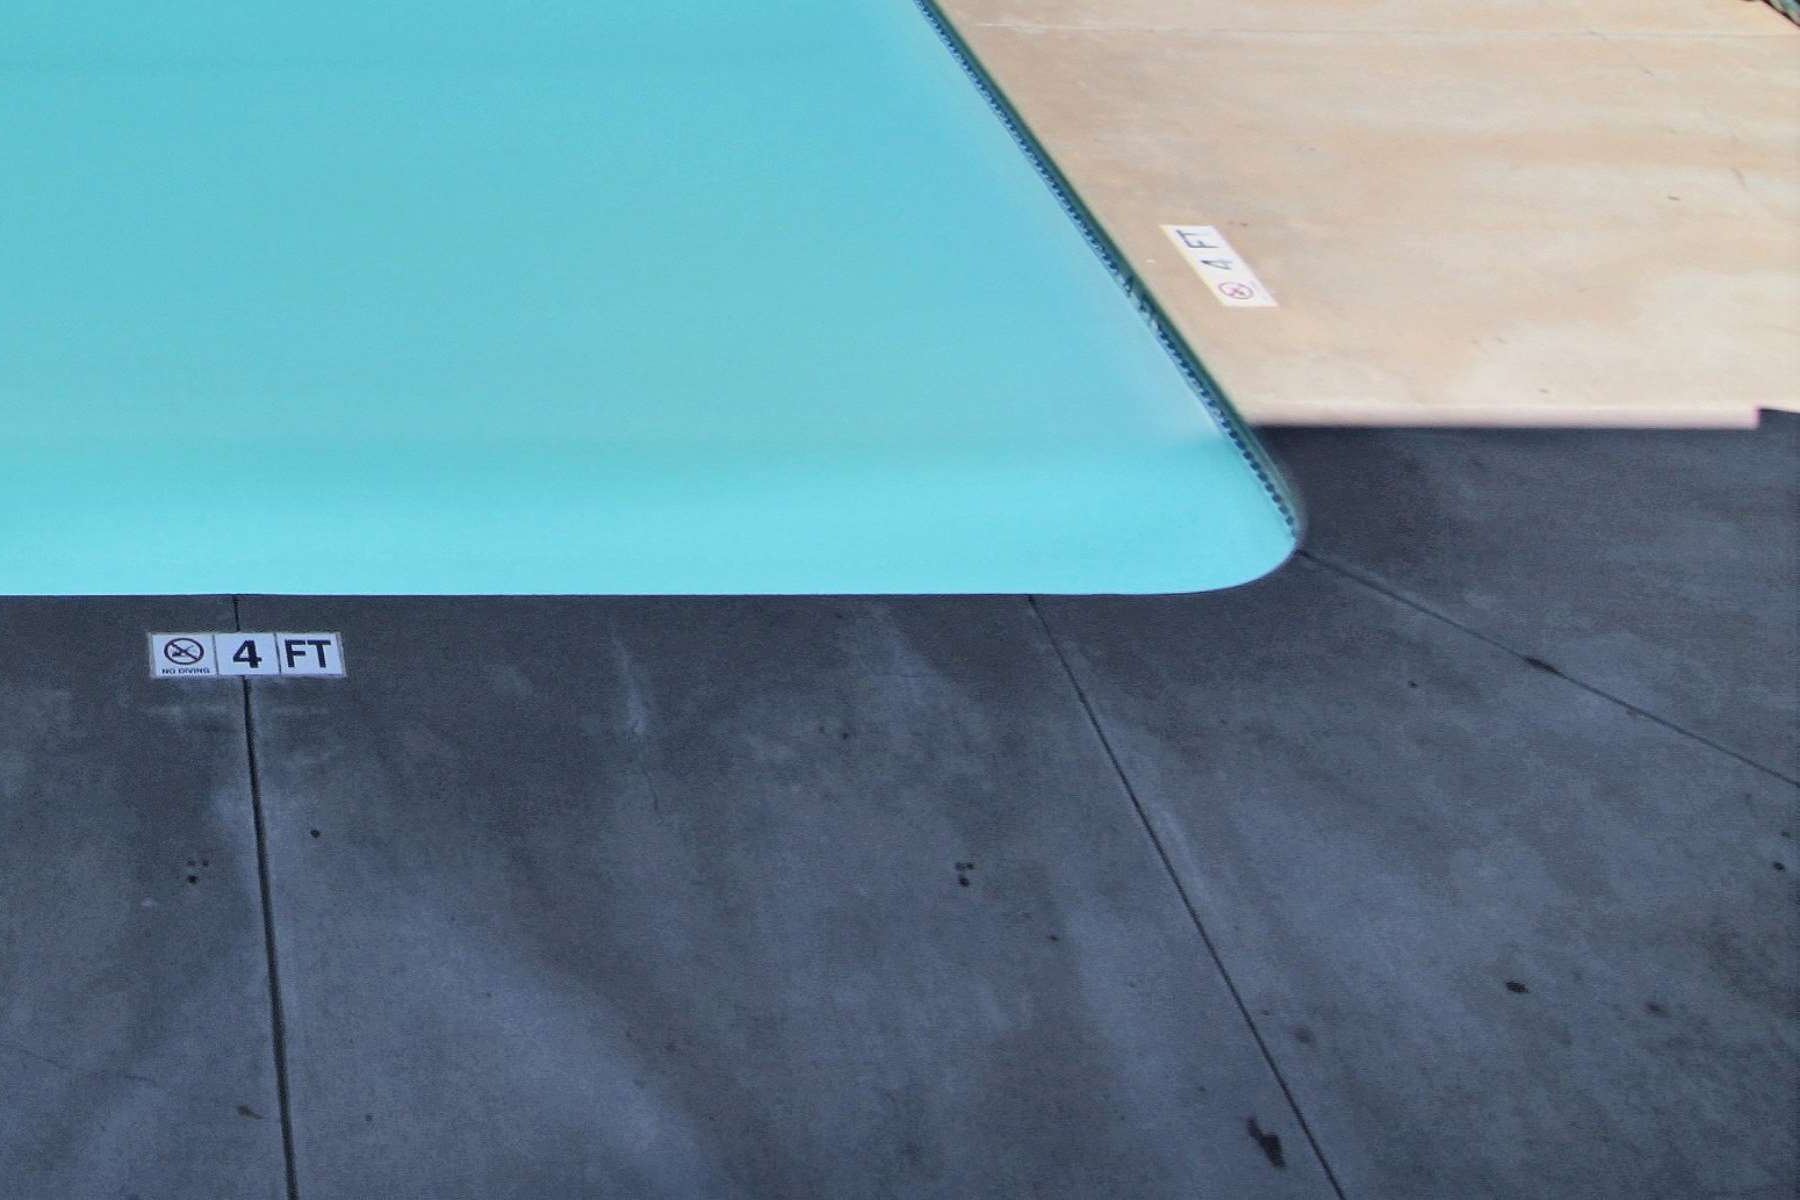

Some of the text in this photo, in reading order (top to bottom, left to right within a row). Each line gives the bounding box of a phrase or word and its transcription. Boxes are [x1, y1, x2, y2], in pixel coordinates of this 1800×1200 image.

[1175, 229, 1233, 271] 4 FT
[232, 638, 332, 669] 4 FT
